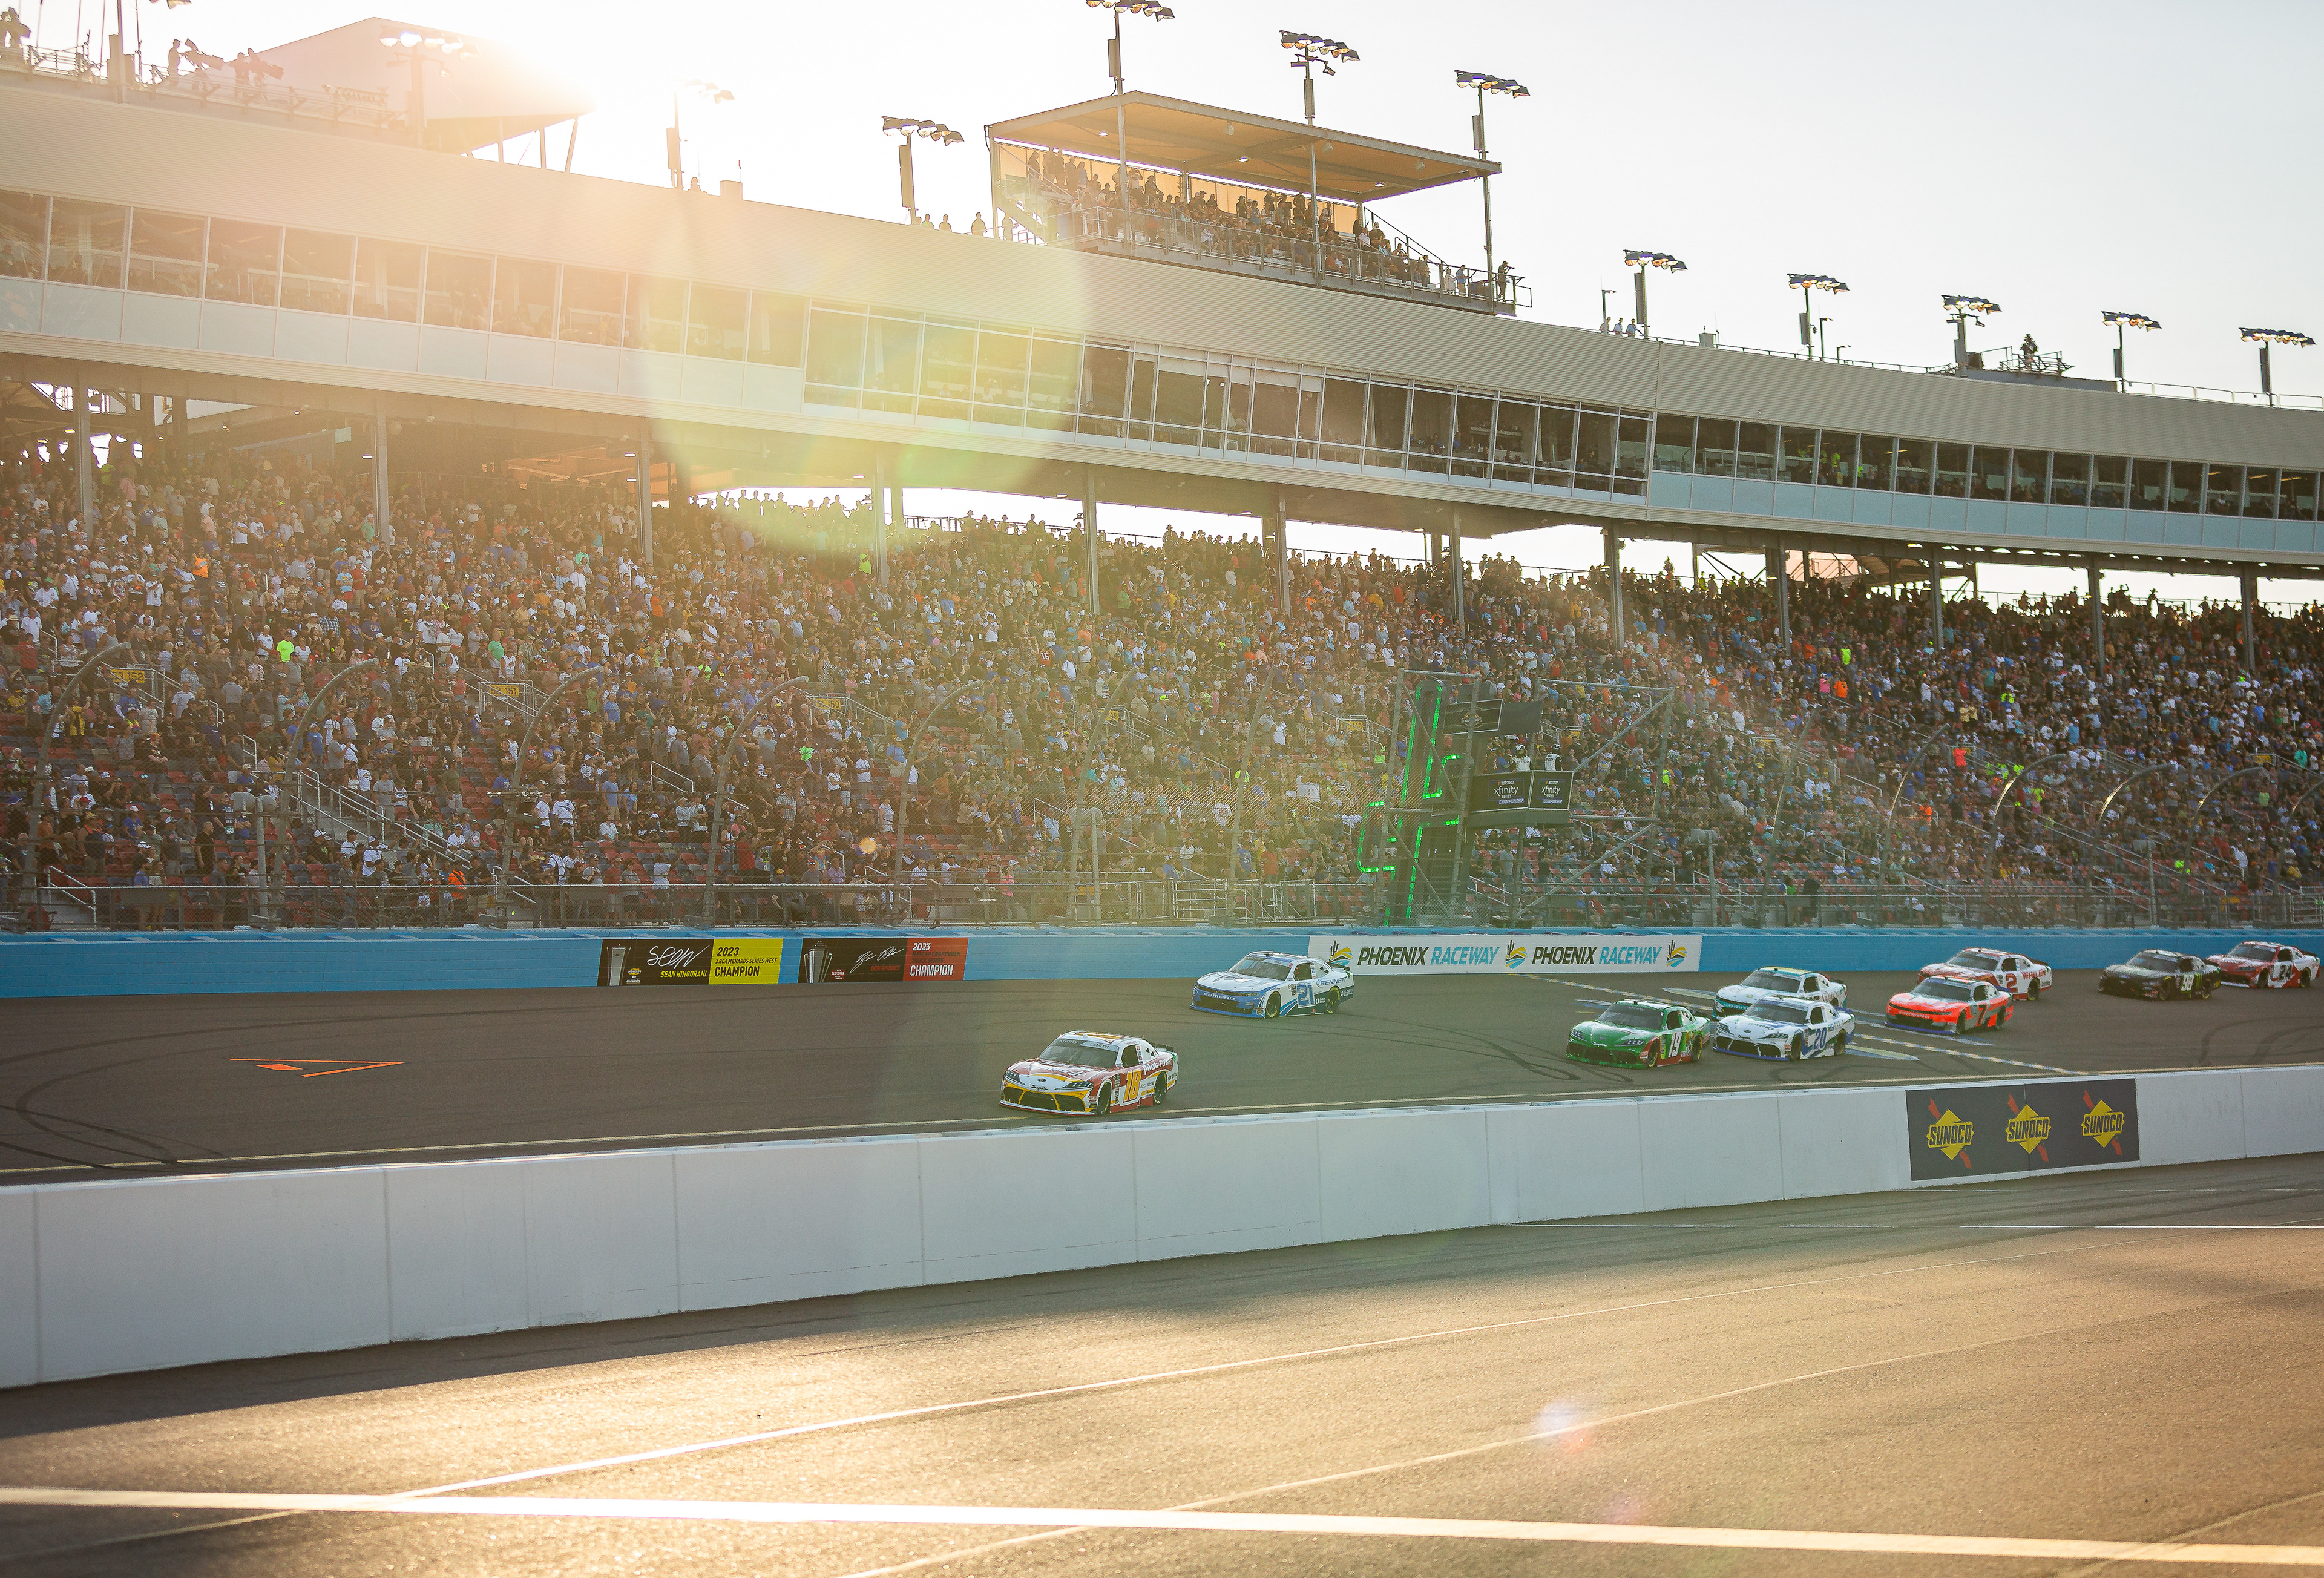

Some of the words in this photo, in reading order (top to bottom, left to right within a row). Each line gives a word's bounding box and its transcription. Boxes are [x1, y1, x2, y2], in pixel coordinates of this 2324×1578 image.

[827, 700, 839, 708] 150
[1494, 785, 1518, 797] xfinity
[1541, 785, 1560, 795] xfinity
[717, 947, 740, 956] 2023
[913, 942, 931, 951] 2023
[1357, 946, 1429, 965] PHOENIX
[1430, 946, 1500, 965] RACEWAY
[1532, 946, 1597, 965] PHOENIX
[1599, 946, 1662, 964] RACEWAY
[714, 966, 760, 977] CHAMPION
[910, 965, 954, 976] CHAMPION
[1320, 976, 1347, 986] BENNETT
[2006, 973, 2018, 993] 2
[2181, 974, 2194, 991] 98
[1296, 982, 1315, 1007] 21
[1976, 1003, 1988, 1027] 7
[1669, 1031, 1682, 1058] 19
[1814, 1027, 1827, 1050] 20
[1123, 1068, 1142, 1102] 18
[2008, 1119, 2049, 1140] SUNOCO
[2084, 1113, 2122, 1134] SUNOCO
[1930, 1125, 1972, 1146] SUNOCO
